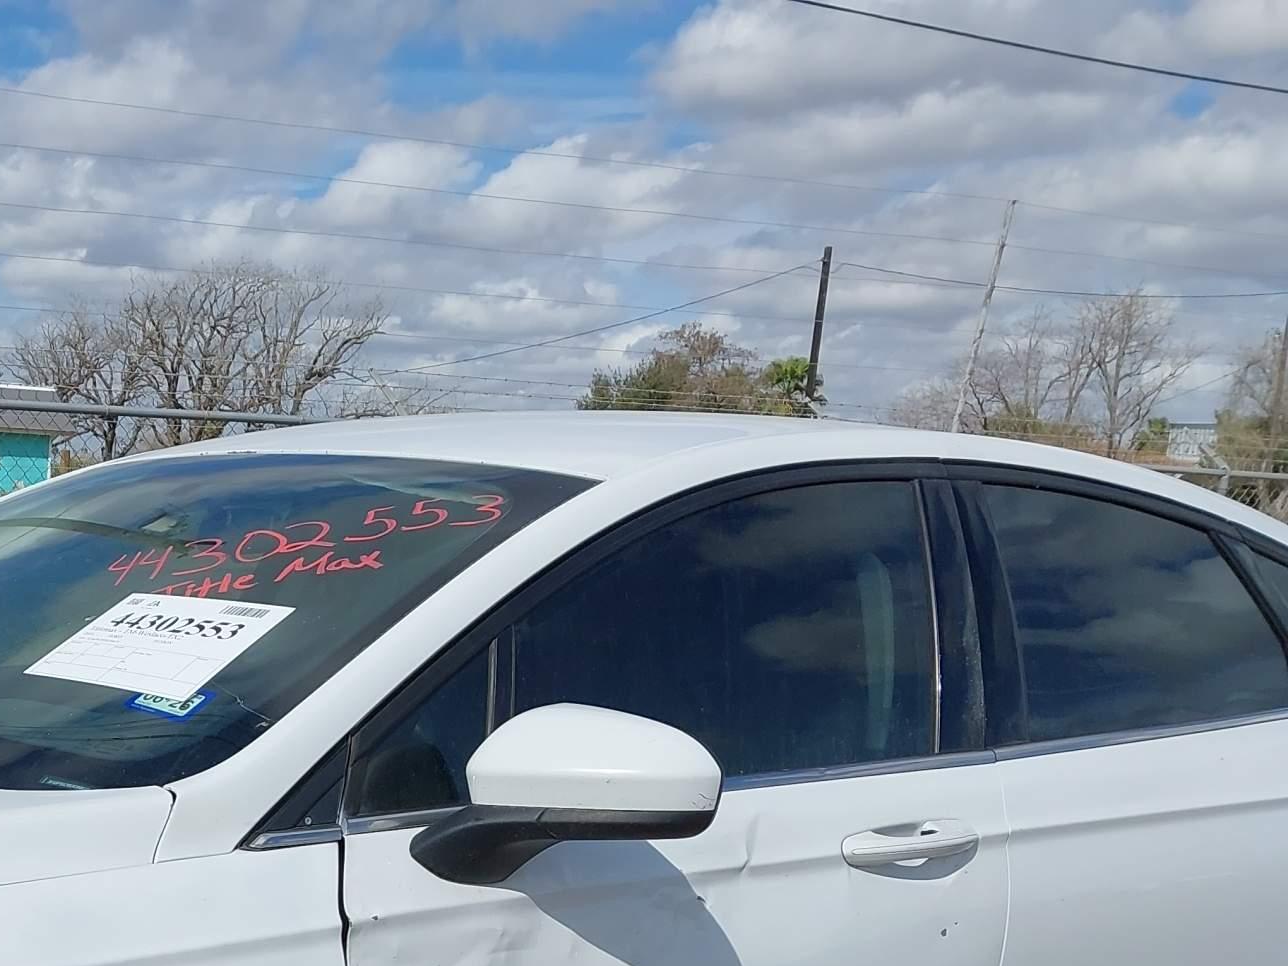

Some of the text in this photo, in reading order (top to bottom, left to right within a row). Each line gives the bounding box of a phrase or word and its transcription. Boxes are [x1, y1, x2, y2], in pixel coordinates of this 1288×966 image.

[108, 495, 504, 586] 44302553
[151, 550, 384, 597] Title Max
[110, 612, 246, 640] 44302553
